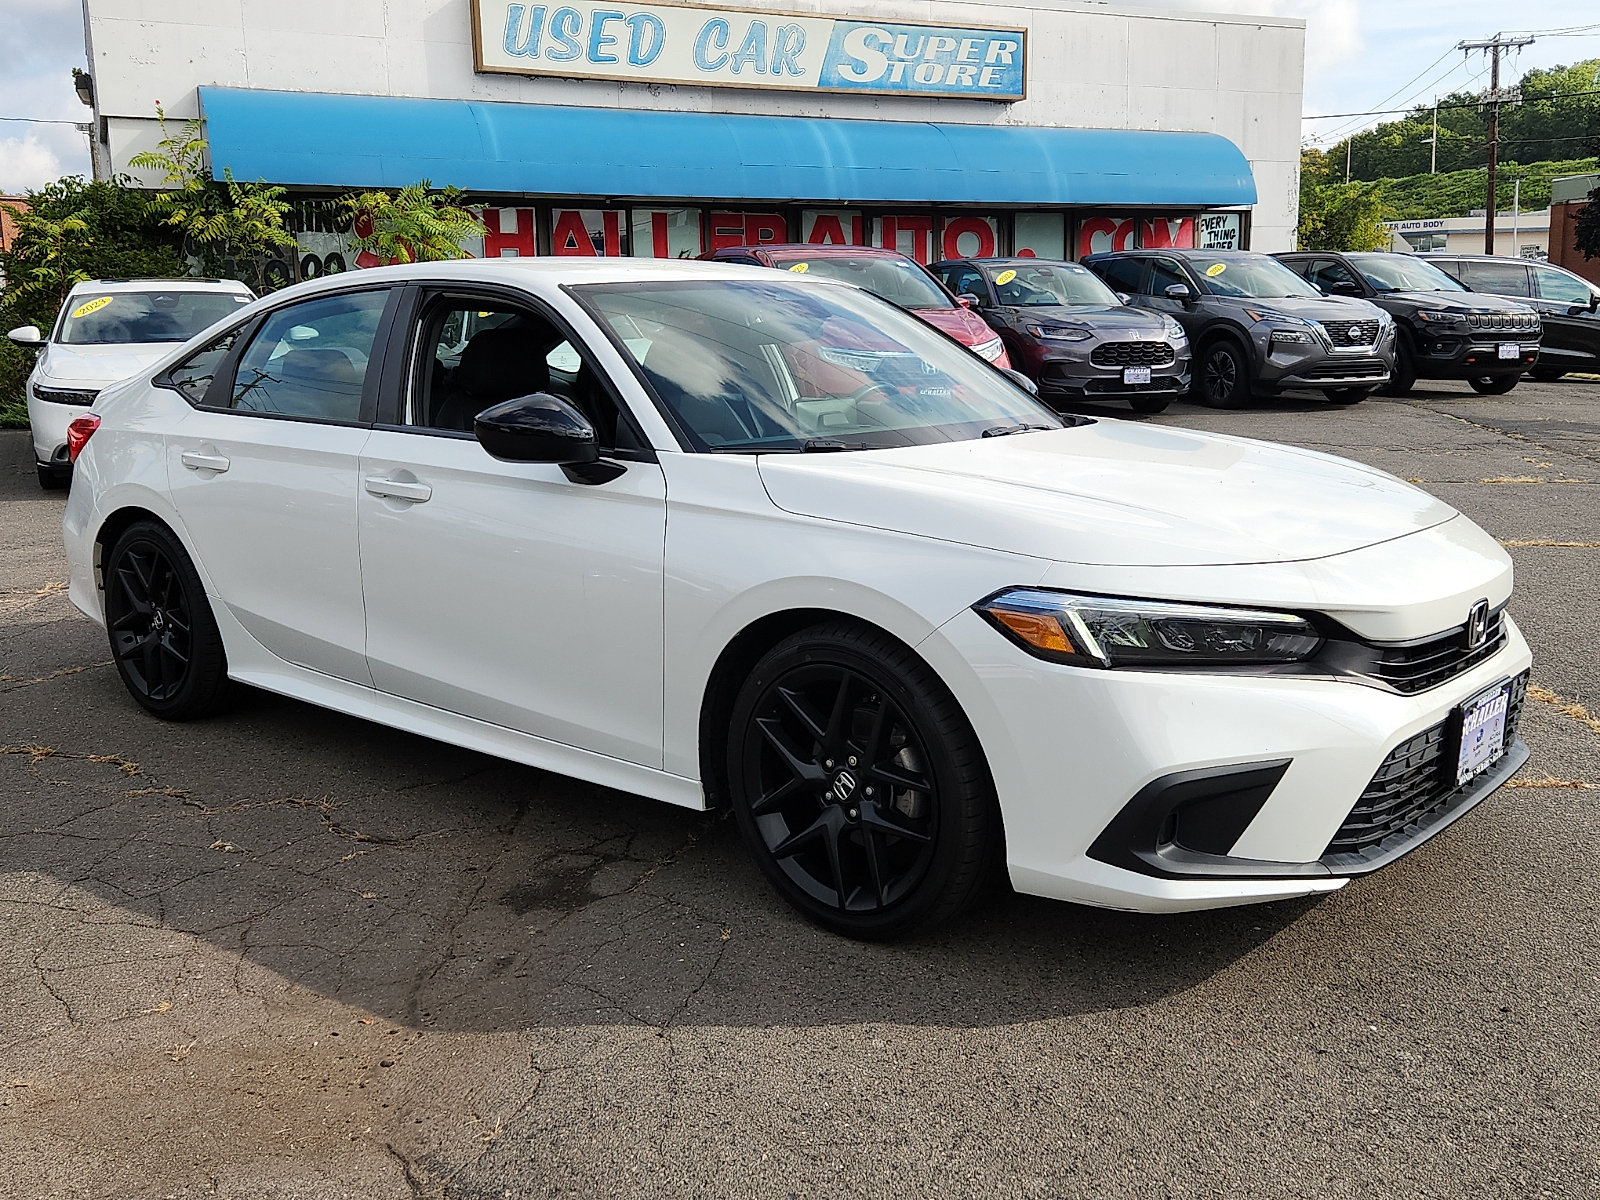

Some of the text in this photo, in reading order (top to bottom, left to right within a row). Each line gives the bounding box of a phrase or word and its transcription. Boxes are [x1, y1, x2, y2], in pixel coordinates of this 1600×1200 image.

[502, 3, 806, 76] USED CAR
[837, 27, 1017, 82] SUPER
[1201, 215, 1228, 232] EVERY
[1401, 222, 1420, 230] AUTO
[1423, 220, 1444, 229] BODY
[1207, 228, 1236, 243] THING
